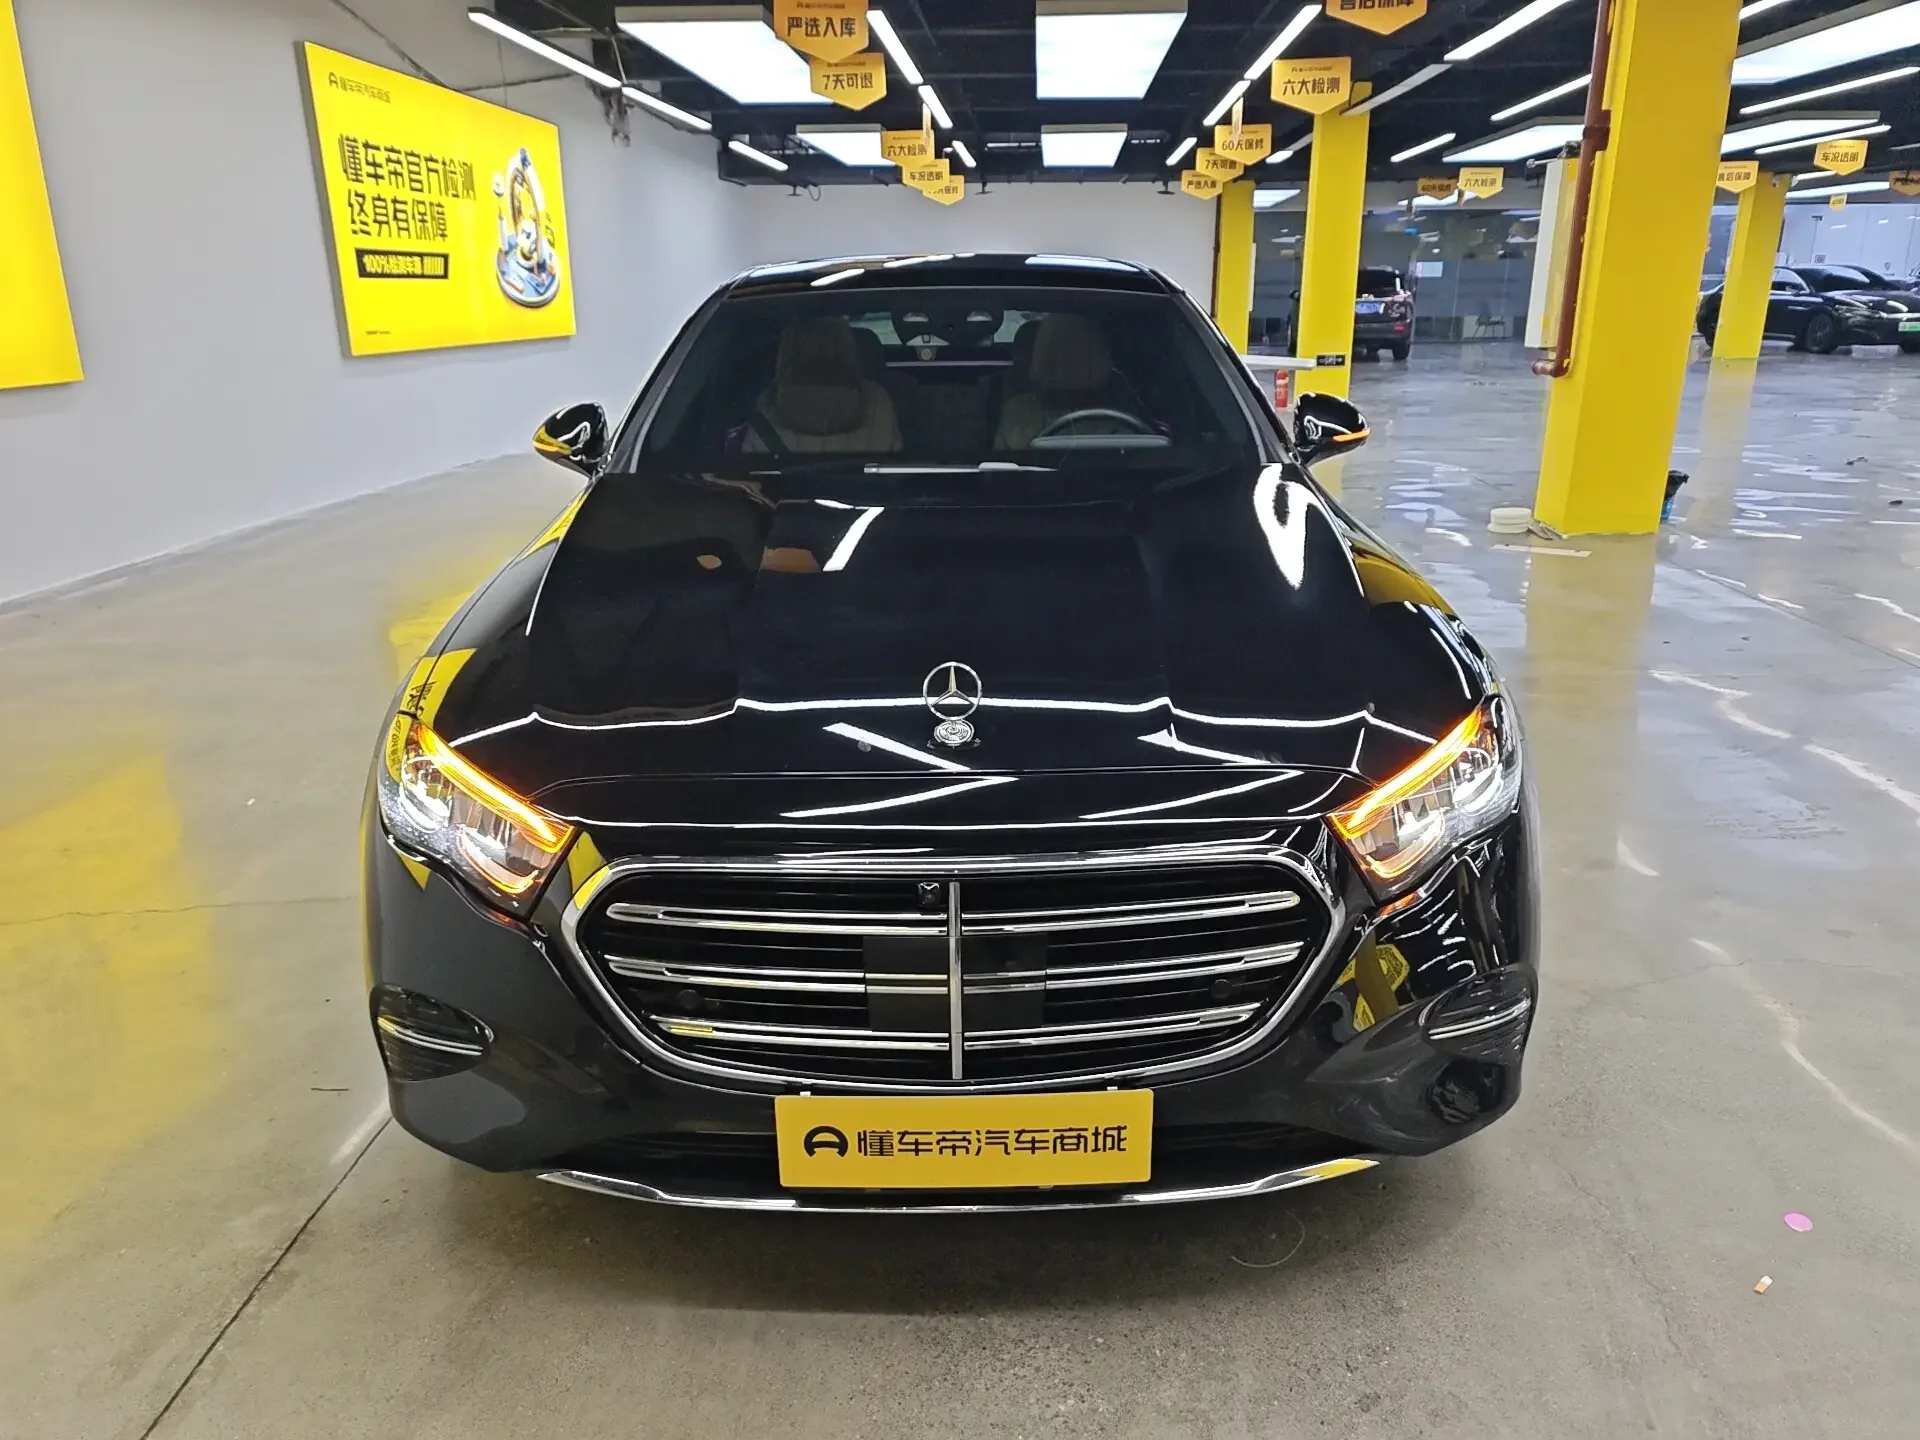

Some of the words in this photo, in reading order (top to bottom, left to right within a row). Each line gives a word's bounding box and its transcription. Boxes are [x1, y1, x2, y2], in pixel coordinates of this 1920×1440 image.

[786, 16, 856, 37] 严选入库
[822, 72, 873, 90] 7天可退
[1283, 76, 1341, 96] 六大检测
[338, 133, 476, 200] 懂车帝官方检测
[1821, 151, 1859, 163] 车况透明
[347, 188, 448, 242] 终身有保障
[856, 1124, 1128, 1157] 懂车帝汽车商城
